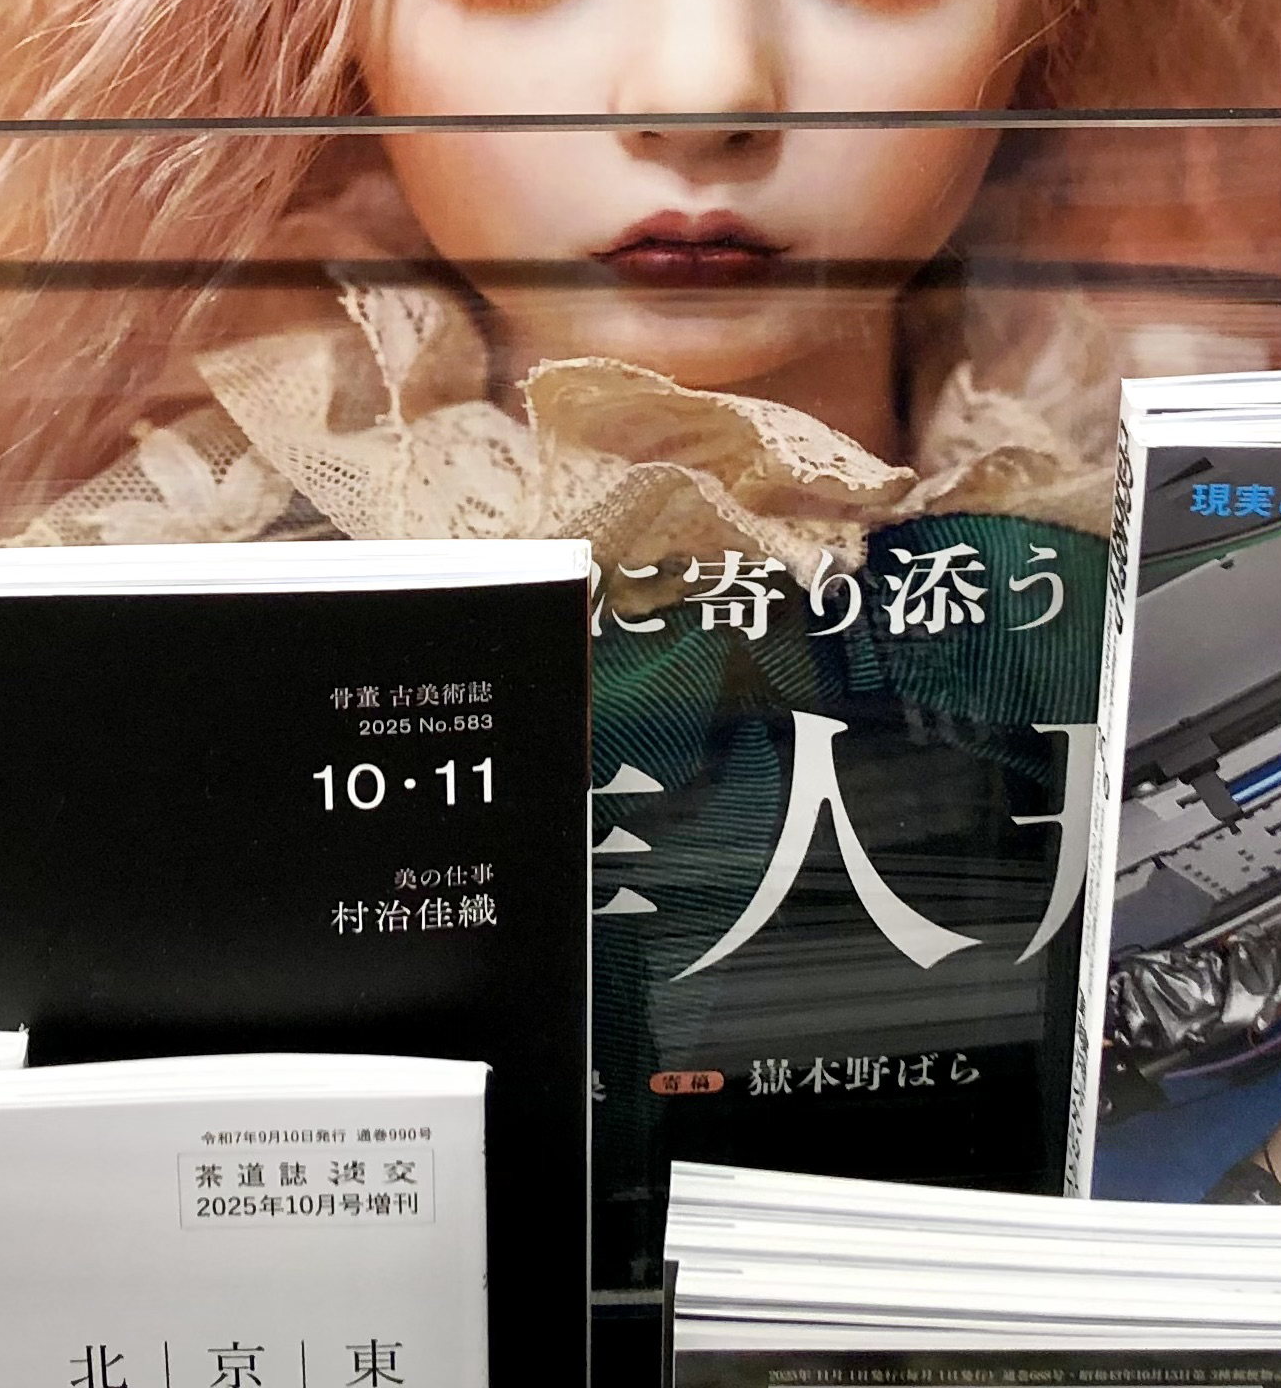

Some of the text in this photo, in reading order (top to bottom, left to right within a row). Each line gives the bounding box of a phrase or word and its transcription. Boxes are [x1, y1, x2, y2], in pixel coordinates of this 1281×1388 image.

[330, 680, 493, 710] 骨董 古美術誌
[359, 714, 493, 736] 2025 No.583
[394, 863, 494, 891] 美の仕事
[330, 893, 498, 935] 村治佳織
[356, 1127, 433, 1143] 通巻990号
[196, 1192, 420, 1218] 2025年10月号増刊
